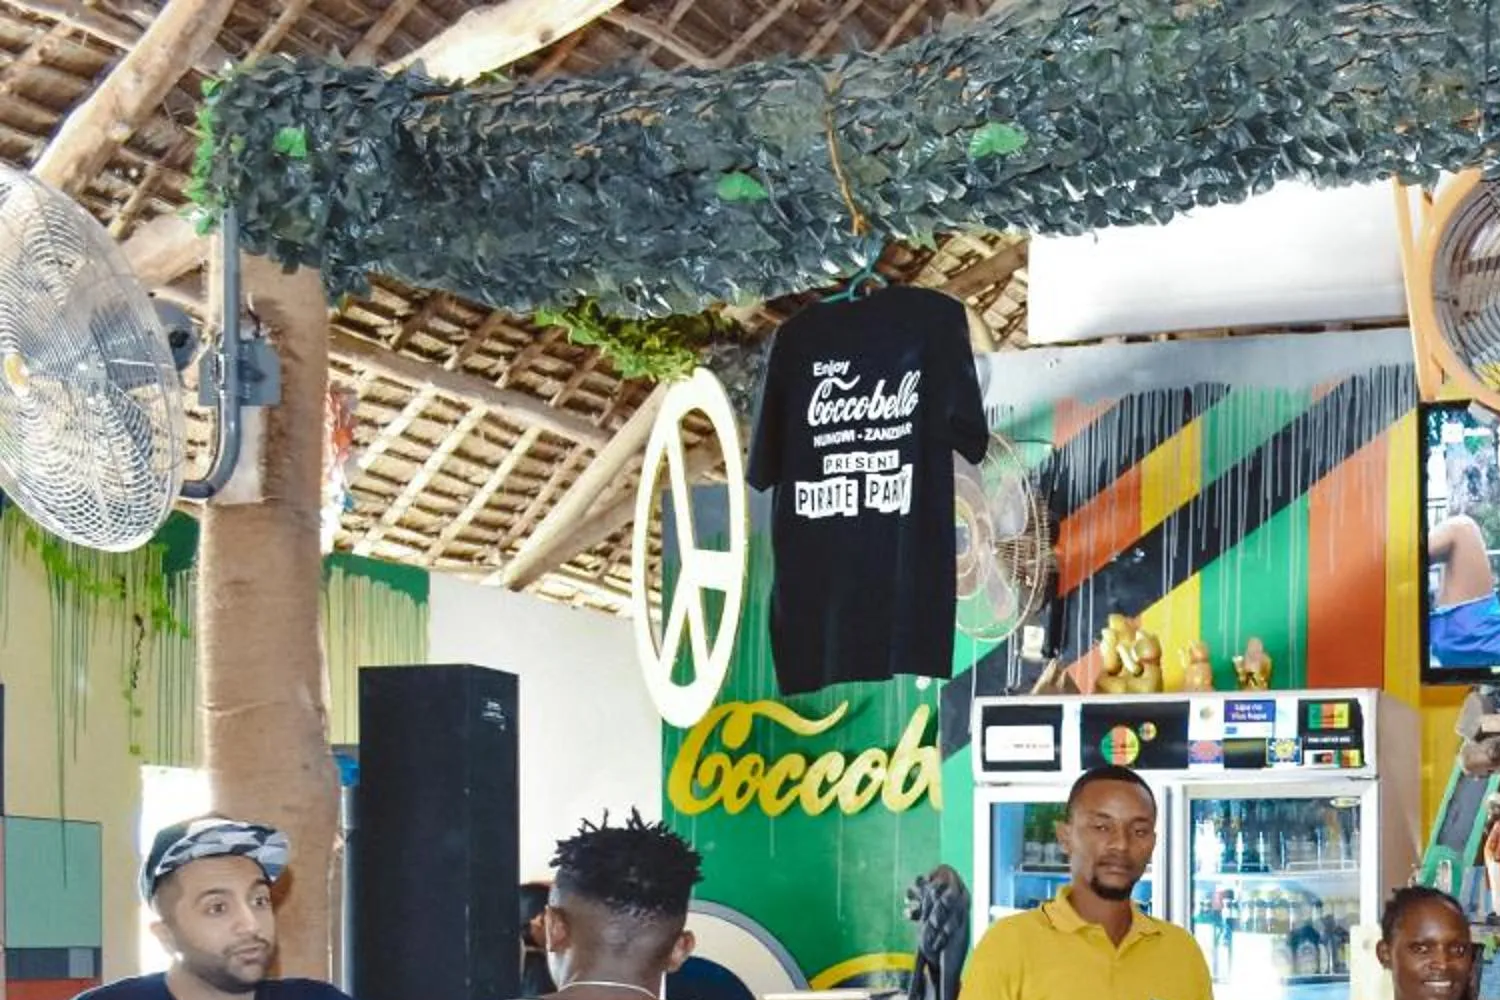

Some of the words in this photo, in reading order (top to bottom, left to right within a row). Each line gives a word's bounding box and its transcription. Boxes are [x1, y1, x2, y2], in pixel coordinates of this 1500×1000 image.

[813, 360, 850, 377] Enjoy
[808, 370, 920, 426] Coccobello
[825, 455, 894, 472] PRESENT
[798, 482, 853, 513] PIRATE
[668, 699, 942, 816] Coccob
